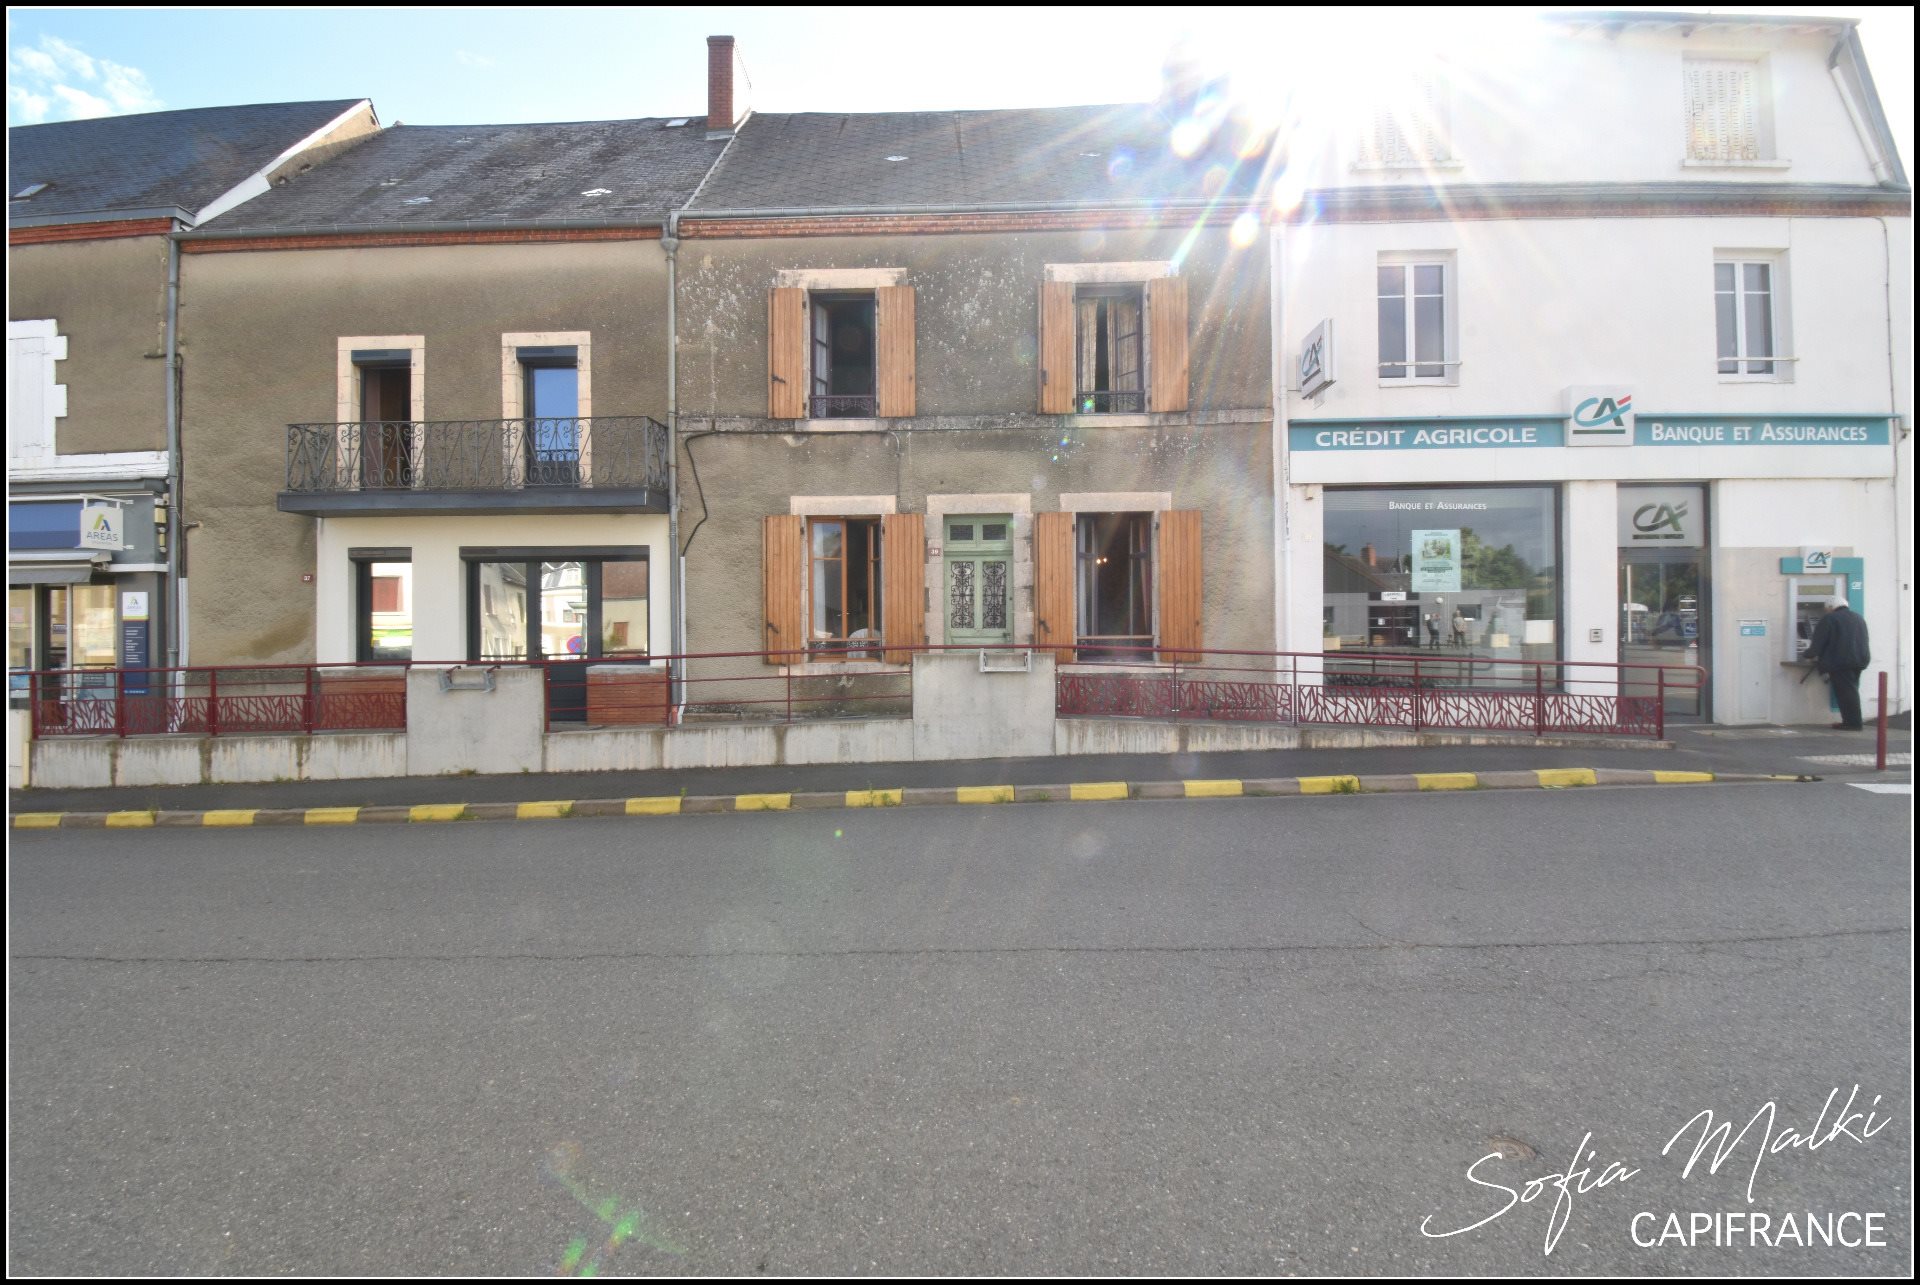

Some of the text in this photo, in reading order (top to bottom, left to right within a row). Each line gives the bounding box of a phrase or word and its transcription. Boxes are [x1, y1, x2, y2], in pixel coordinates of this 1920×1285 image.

[1315, 427, 1537, 447] CRÉDIT AGRICOLE
[1651, 422, 1724, 443] BANQUE
[1760, 422, 1868, 441] ASSURANCES
[86, 531, 119, 542] AREAS
